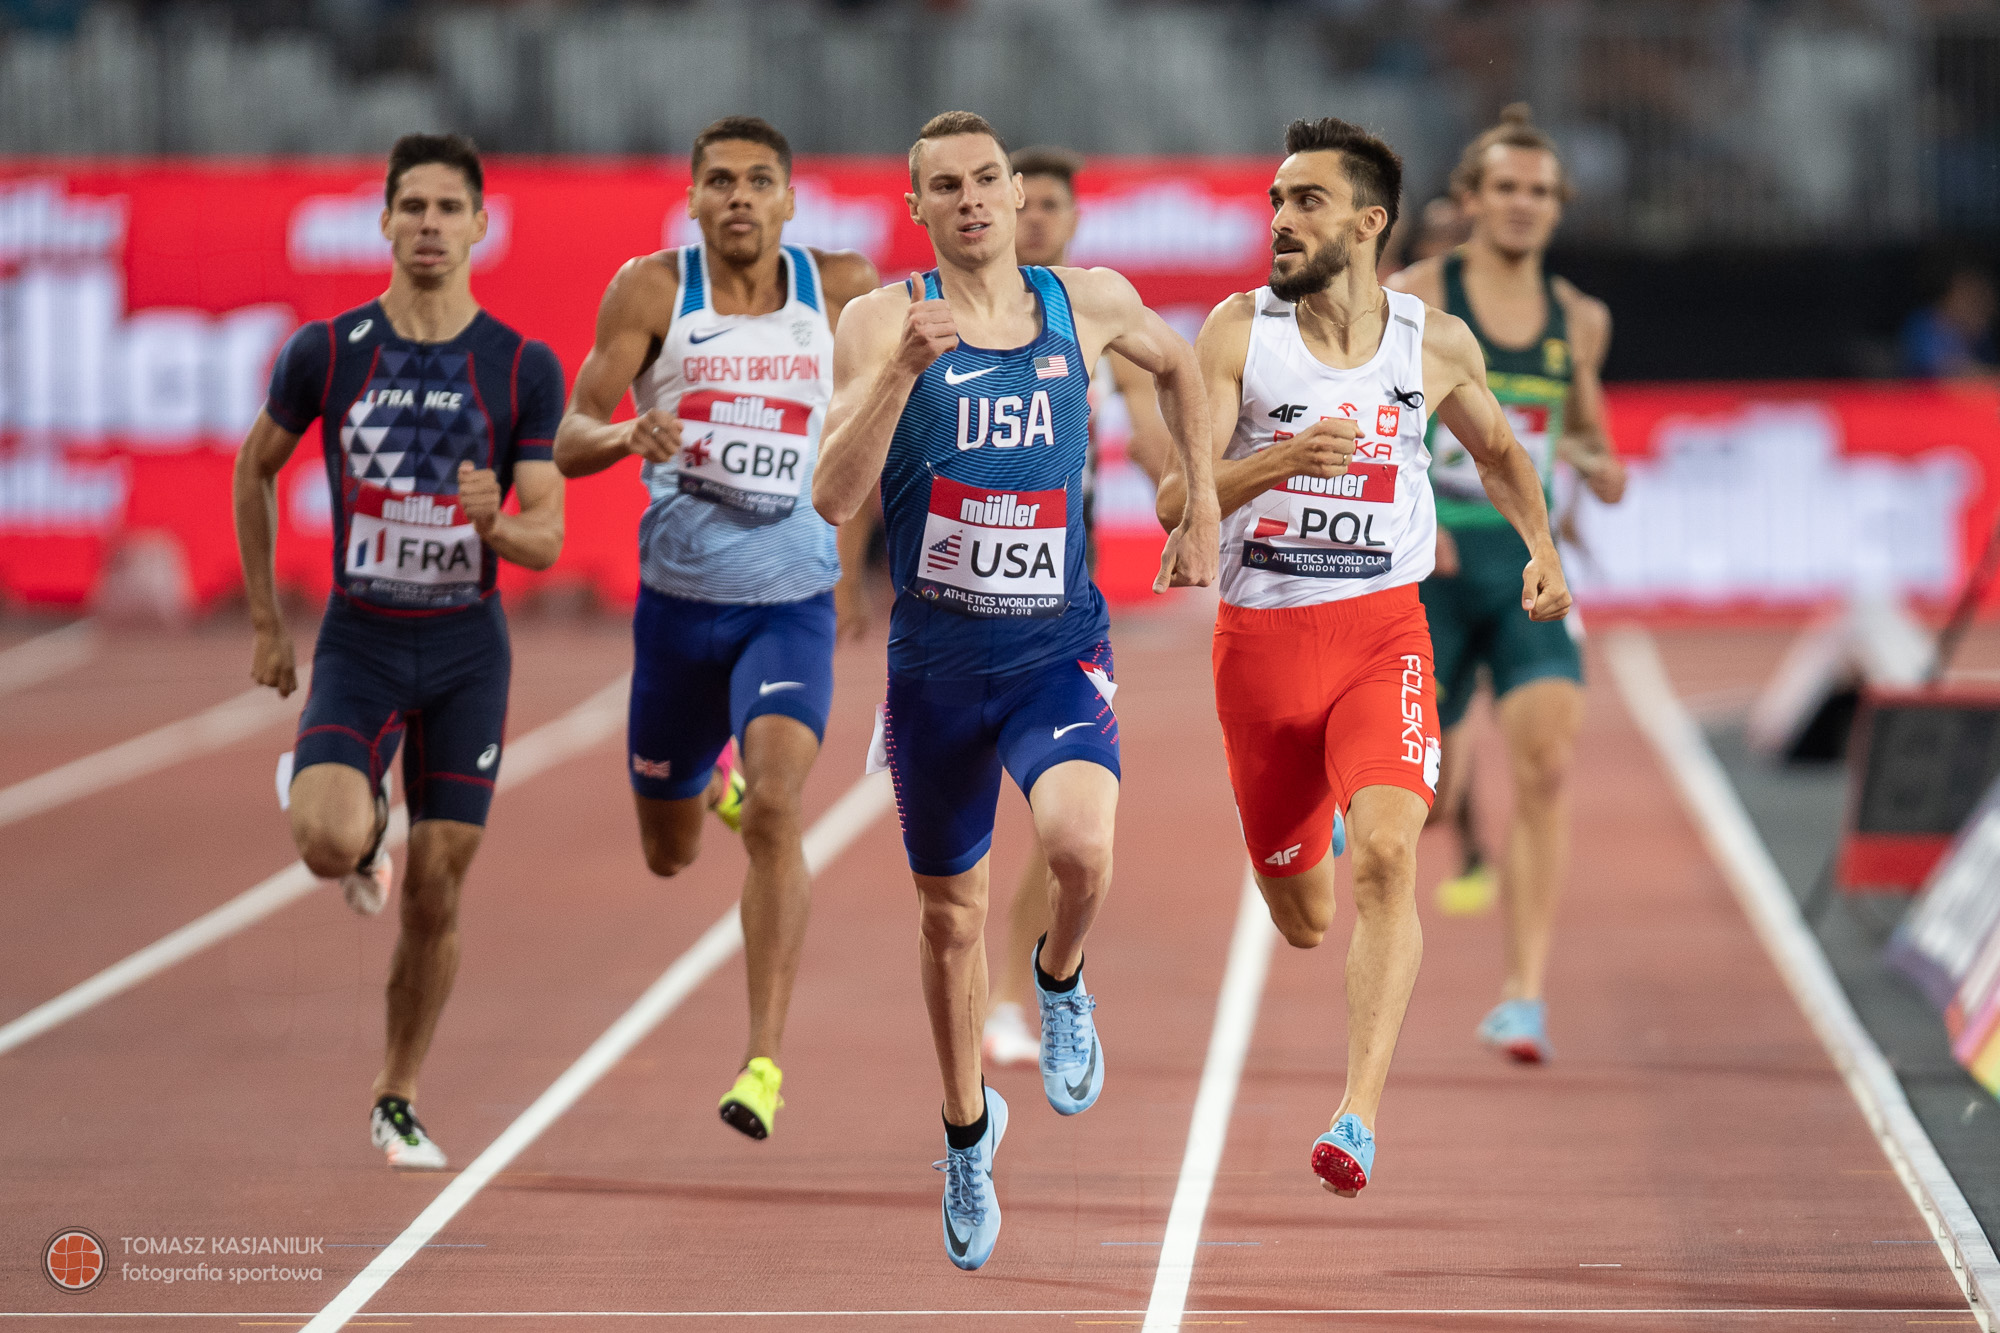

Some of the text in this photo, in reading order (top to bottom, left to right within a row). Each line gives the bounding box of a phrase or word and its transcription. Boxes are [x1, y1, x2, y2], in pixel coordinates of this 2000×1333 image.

[683, 355, 820, 383] GREAT BRITAIN
[709, 396, 785, 430] müller
[956, 390, 1055, 451] USA
[1268, 403, 1308, 423] 4F
[721, 440, 800, 480] GBR
[381, 495, 456, 526] müller
[960, 493, 1040, 527] müller
[1299, 507, 1386, 546] POL
[397, 537, 471, 570] FRA
[970, 540, 1057, 579] USA
[1271, 552, 1386, 566] ATHLETICS WORLD CUP
[1296, 564, 1360, 573] LONDON 2018
[943, 588, 1058, 608] ATHLETICS WORLD CUP
[967, 604, 1032, 616] LONDON 2018
[1264, 842, 1302, 866] 4F
